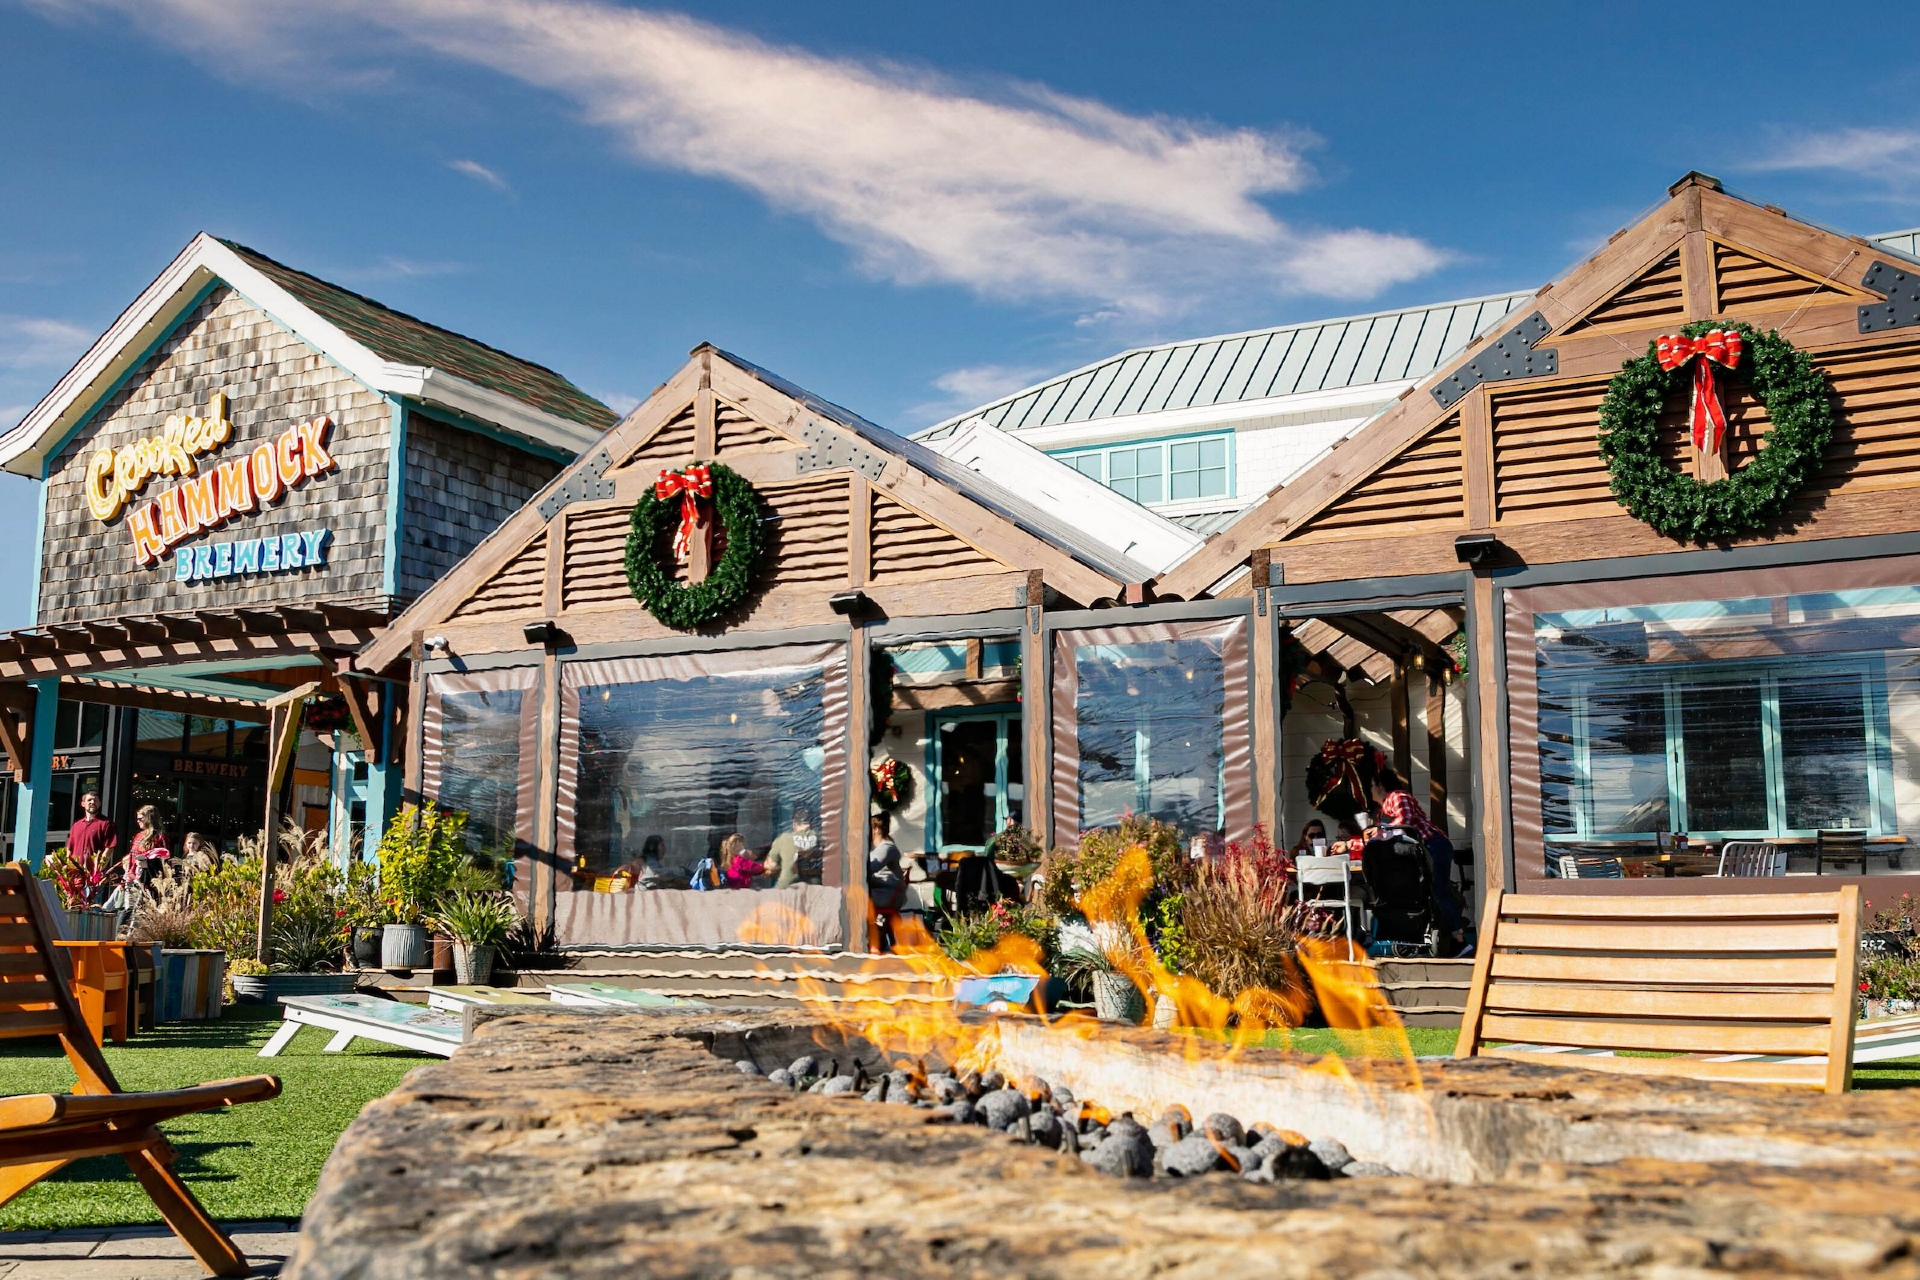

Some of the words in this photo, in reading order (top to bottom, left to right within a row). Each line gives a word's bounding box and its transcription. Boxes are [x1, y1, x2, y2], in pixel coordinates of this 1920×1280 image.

[85, 393, 232, 521] Crooked
[127, 416, 334, 566] HAMMOCK
[175, 528, 331, 582] BREWERY
[173, 758, 248, 777] BREWERY
